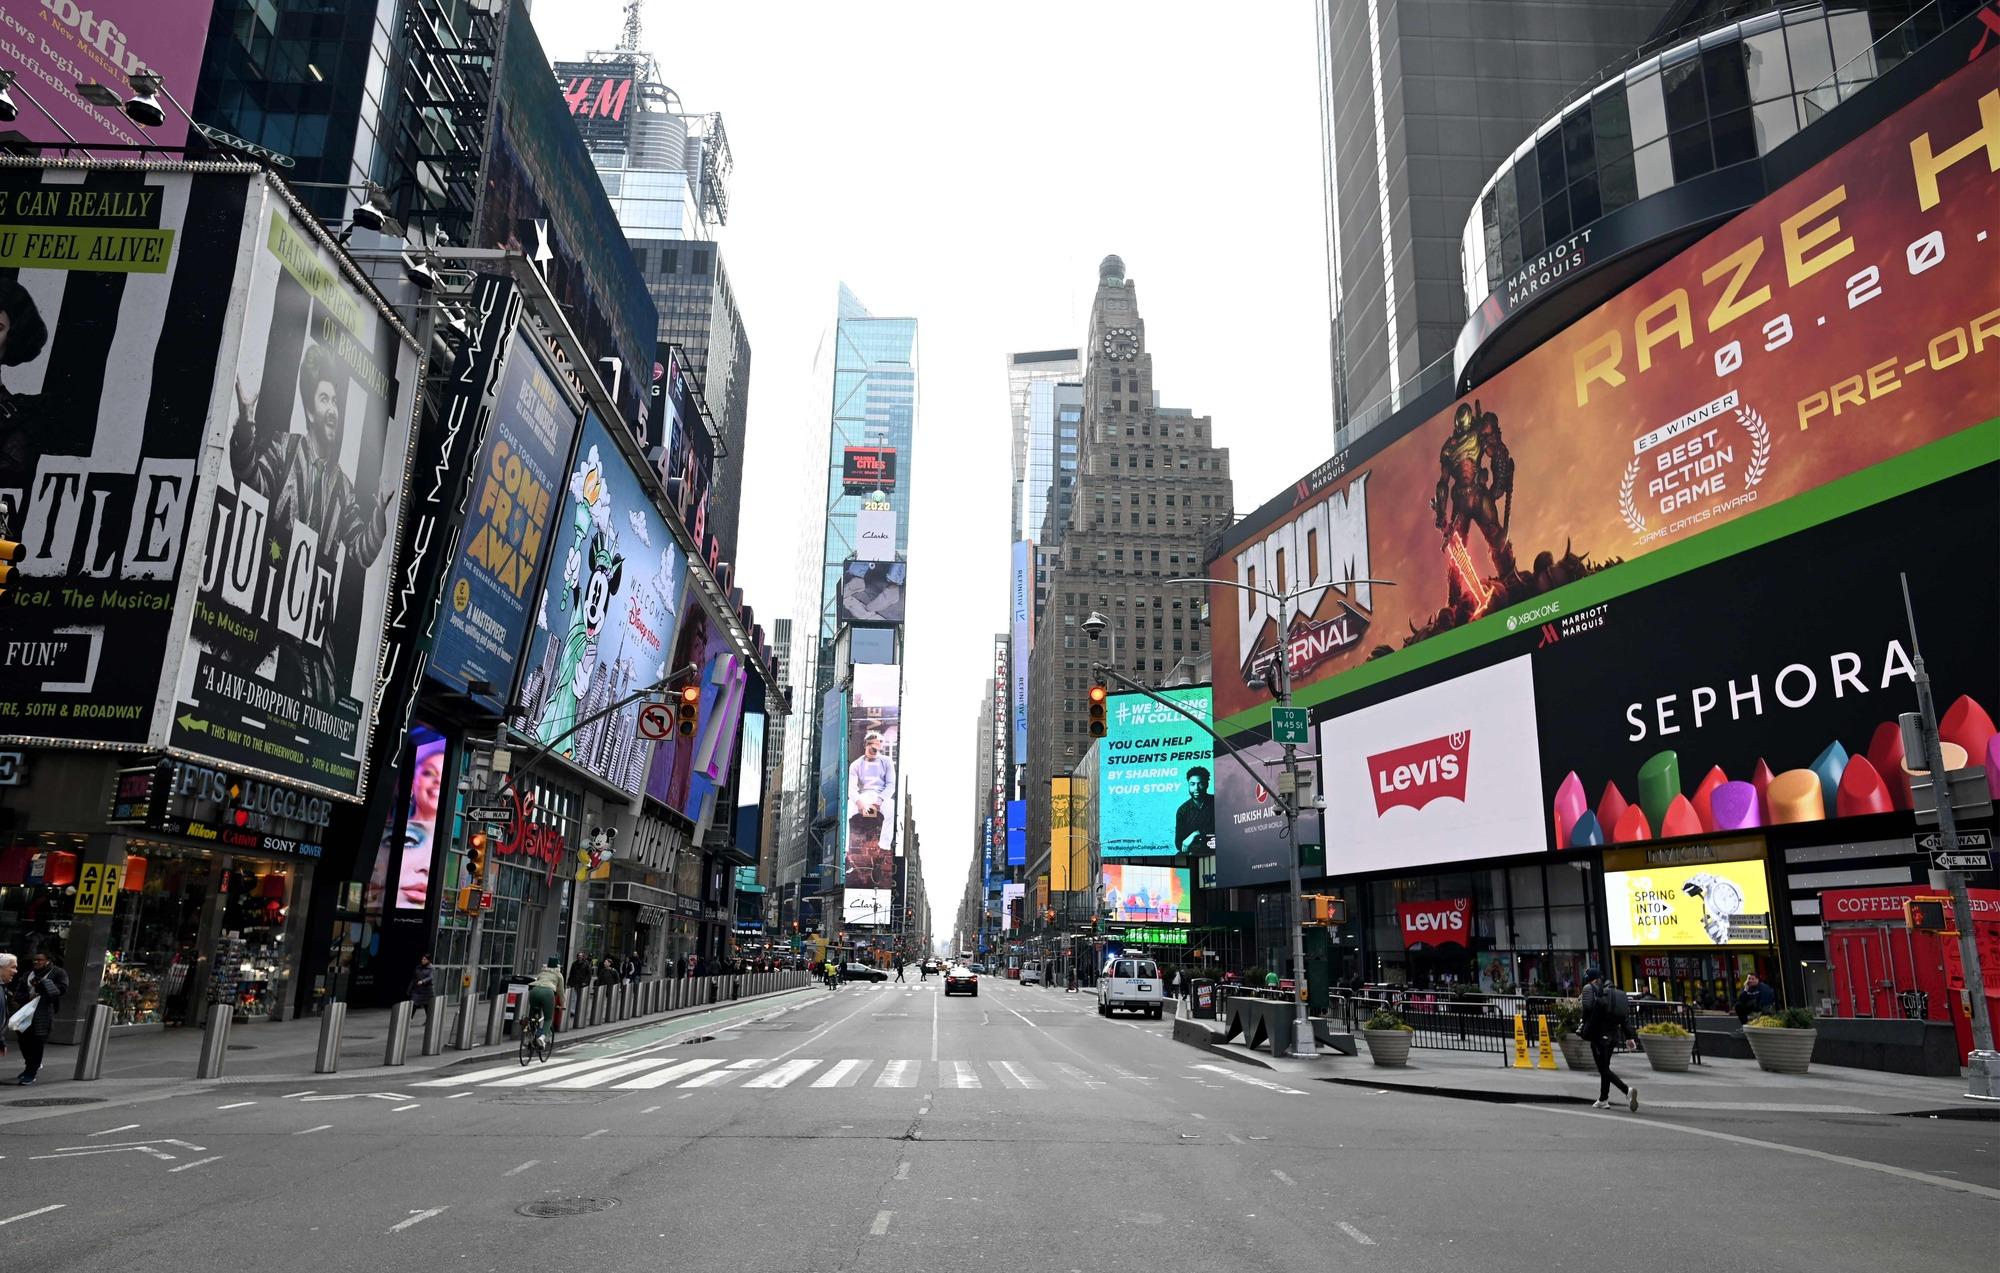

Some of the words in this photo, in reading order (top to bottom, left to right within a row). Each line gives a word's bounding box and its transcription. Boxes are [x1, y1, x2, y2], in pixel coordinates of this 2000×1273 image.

[39, 9, 48, 21] A
[51, 17, 74, 41] New
[41, 0, 160, 82] btfir
[40, 38, 85, 82] begin
[564, 77, 632, 121] H&M
[203, 128, 286, 165] LAMAR
[16, 192, 61, 216] CAN
[67, 192, 154, 217] REALLY
[24, 233, 80, 260] FEEL
[88, 235, 165, 263] ALIVE!
[1508, 229, 1592, 292] MARRIOTT
[278, 227, 321, 291] RAISING
[322, 279, 358, 332] SPIRITS
[1510, 253, 1582, 308] MARQUIS
[1573, 184, 1856, 408] RAZE
[323, 317, 336, 345] ON
[339, 335, 390, 398] BROADWAY!
[519, 378, 537, 413] BEST
[534, 403, 558, 445] MUSICAL
[1639, 424, 1658, 451] E3
[1667, 394, 1734, 437] WINNER
[499, 422, 518, 450] COME
[518, 444, 547, 484] TOGETHER
[857, 460, 886, 469] CITIES
[1312, 449, 1350, 479] MARRIOTT
[1657, 429, 1718, 472] BEST
[491, 441, 550, 529] COME
[1312, 464, 1347, 492] MARQUIS
[1649, 446, 1733, 497] ACTION
[864, 502, 891, 511] 2020
[1660, 473, 1726, 515] GAME
[1669, 511, 1711, 535] CRITICS
[1712, 490, 1758, 518] AWARD
[862, 531, 889, 539] Clarks
[466, 522, 535, 599] AWAY
[1235, 470, 1372, 672] DOOM
[463, 557, 472, 570] THE
[472, 564, 500, 594] REMARKABLE
[500, 588, 511, 603] TRUE
[14, 590, 53, 609] ical.
[62, 588, 95, 608] The
[195, 601, 215, 625] The
[630, 575, 665, 627] WELCOME
[473, 606, 508, 645] MASTERPIECE!
[1561, 603, 1609, 628] MARRIOTT
[1562, 616, 1604, 637] MARQUIS
[647, 630, 661, 652] store
[216, 671, 300, 722] JAW-DROPPING
[1626, 639, 1918, 742] SEPHORA
[25, 703, 57, 718] 50TH
[59, 704, 69, 718] &
[73, 704, 143, 720] BROADWAY
[1131, 703, 1152, 714] WE
[1131, 714, 1145, 725] IN
[1276, 721, 1283, 729] W
[1284, 721, 1295, 729] 45
[1296, 720, 1304, 729] St
[1285, 711, 1295, 719] TO
[211, 725, 226, 740] THIS
[227, 730, 242, 745] WAY
[242, 736, 251, 748] TO
[252, 738, 263, 752] THE
[264, 743, 304, 765] NETHERWORLD
[311, 757, 325, 772] 50TH
[330, 763, 357, 781] BROADWAY
[1107, 752, 1168, 765] STUDENTS
[1108, 739, 1132, 750] YOU
[1134, 738, 1159, 749] CAN
[1162, 735, 1193, 746] HELP
[1107, 770, 1123, 780] BY
[1125, 767, 1178, 779] SHARING
[1107, 784, 1137, 795] YOUR
[1139, 782, 1182, 793] STORY
[160, 757, 227, 802] IFTS
[241, 780, 333, 828] LUGGAGE
[1233, 809, 1262, 825] TURKISH
[1257, 823, 1268, 832] YOUR
[1268, 820, 1283, 829] WORLD
[186, 822, 217, 840] Nikon
[223, 829, 259, 848] Canon
[263, 837, 296, 854] SONY
[299, 843, 323, 858] BOWER
[1926, 838, 1942, 847] ON
[1958, 836, 1980, 845] WAY
[1940, 857, 1957, 865] ONE
[1965, 856, 1982, 865] WAY
[80, 866, 98, 906] ATM
[102, 867, 117, 907] ATM
[1634, 889, 1676, 902] SPRING
[850, 898, 882, 909] Clars
[1636, 903, 1661, 914] INTO
[1637, 915, 1678, 926] ACTION
